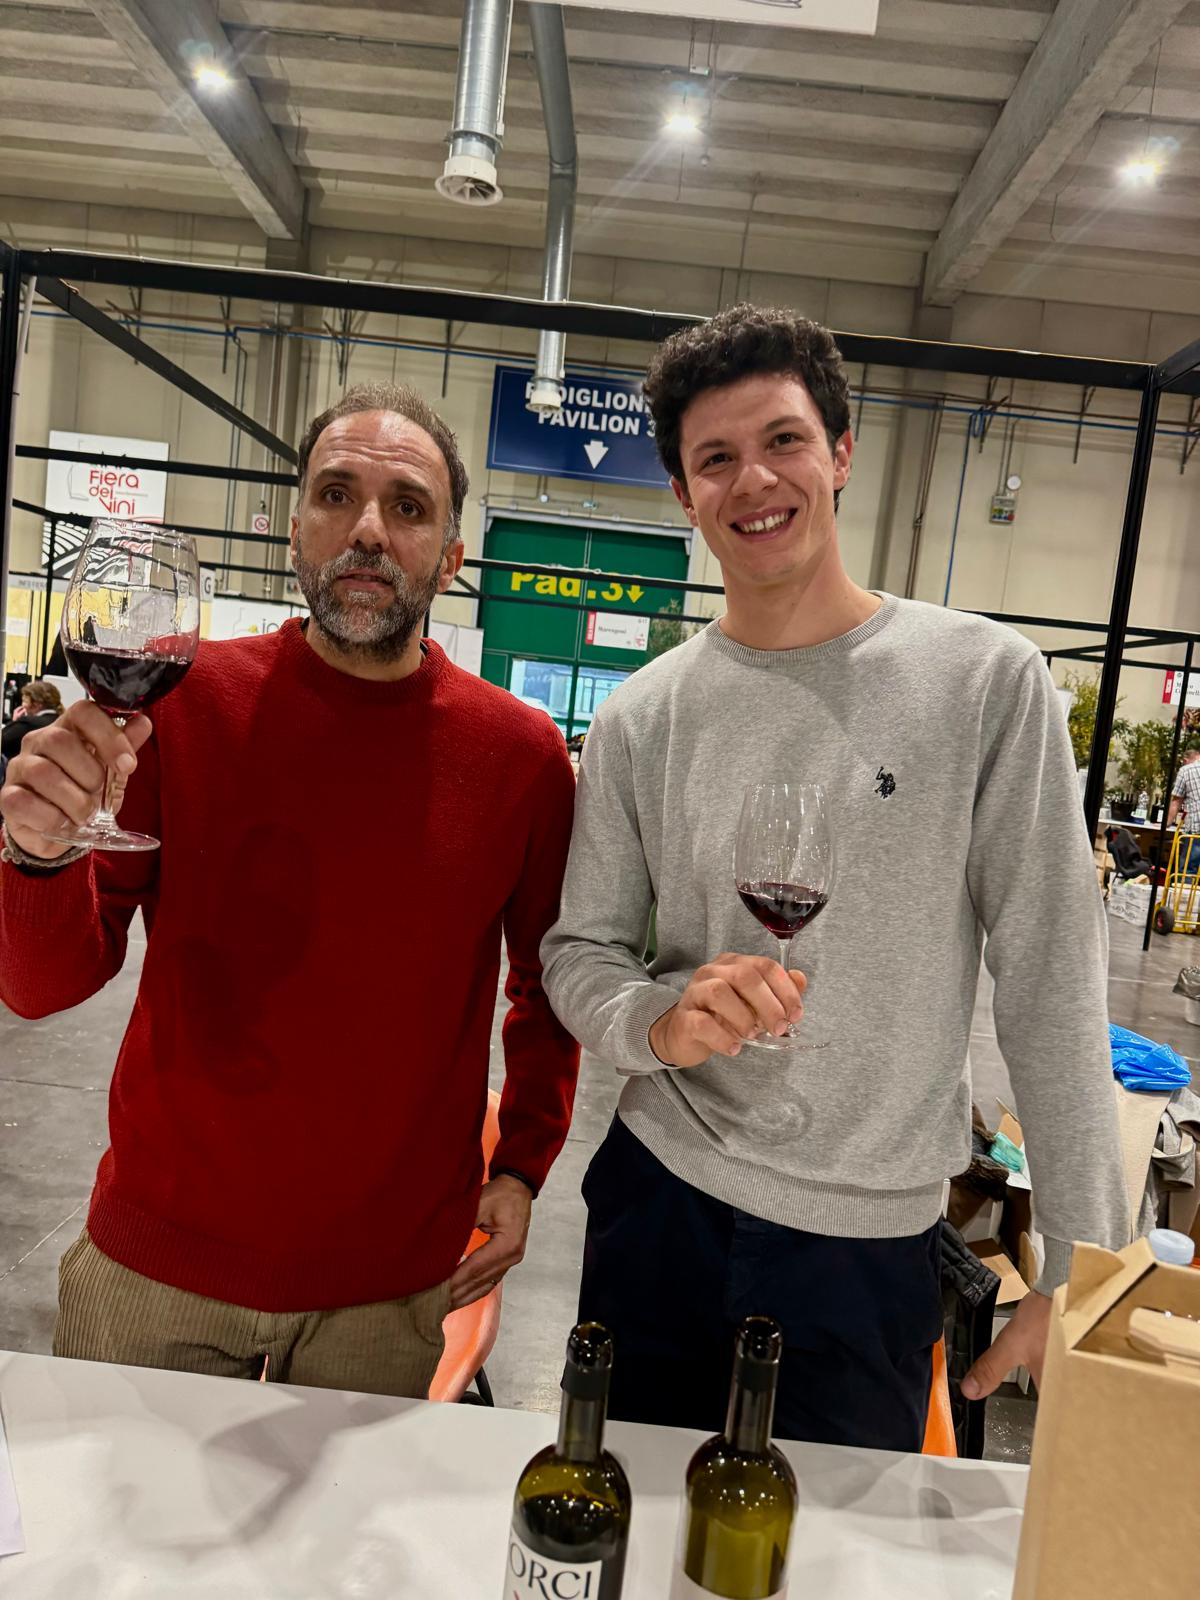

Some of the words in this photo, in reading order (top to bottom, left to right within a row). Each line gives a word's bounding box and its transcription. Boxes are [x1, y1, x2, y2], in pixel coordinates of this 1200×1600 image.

[525, 382, 653, 413] PDIGLION
[538, 409, 640, 436] PAVILION
[88, 469, 139, 489] Fiera
[88, 485, 113, 500] dei
